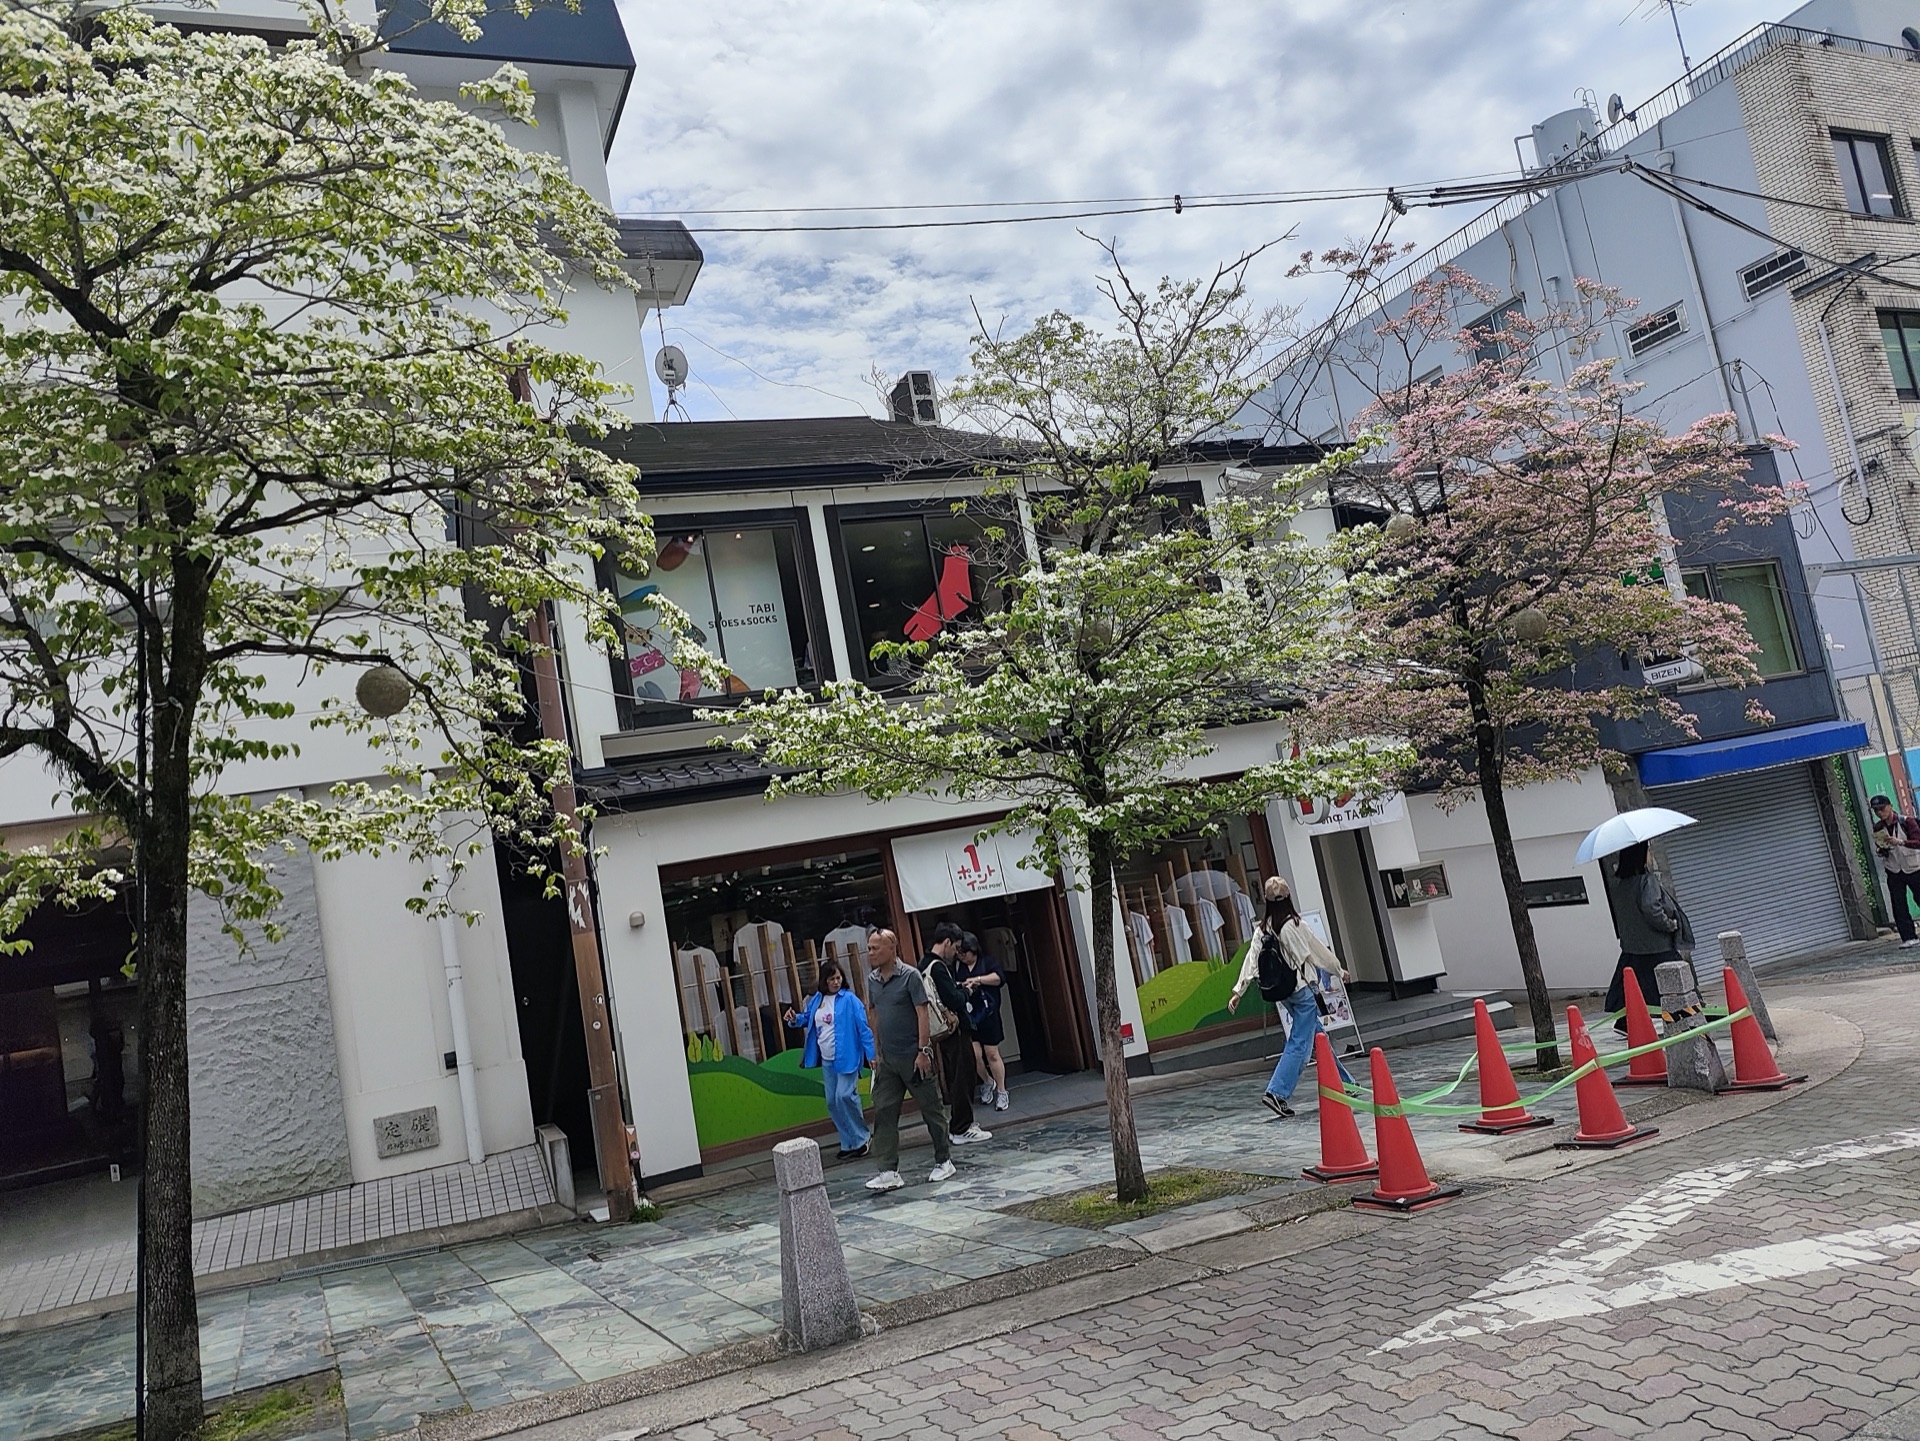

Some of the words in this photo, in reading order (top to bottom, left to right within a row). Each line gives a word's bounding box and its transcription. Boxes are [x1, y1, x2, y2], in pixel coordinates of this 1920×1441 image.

[748, 602, 776, 615] TABI
[708, 614, 778, 629] SOES&SOCKS
[1651, 666, 1682, 680] BIZEN
[964, 844, 981, 873] 1
[957, 864, 996, 892] ポイント
